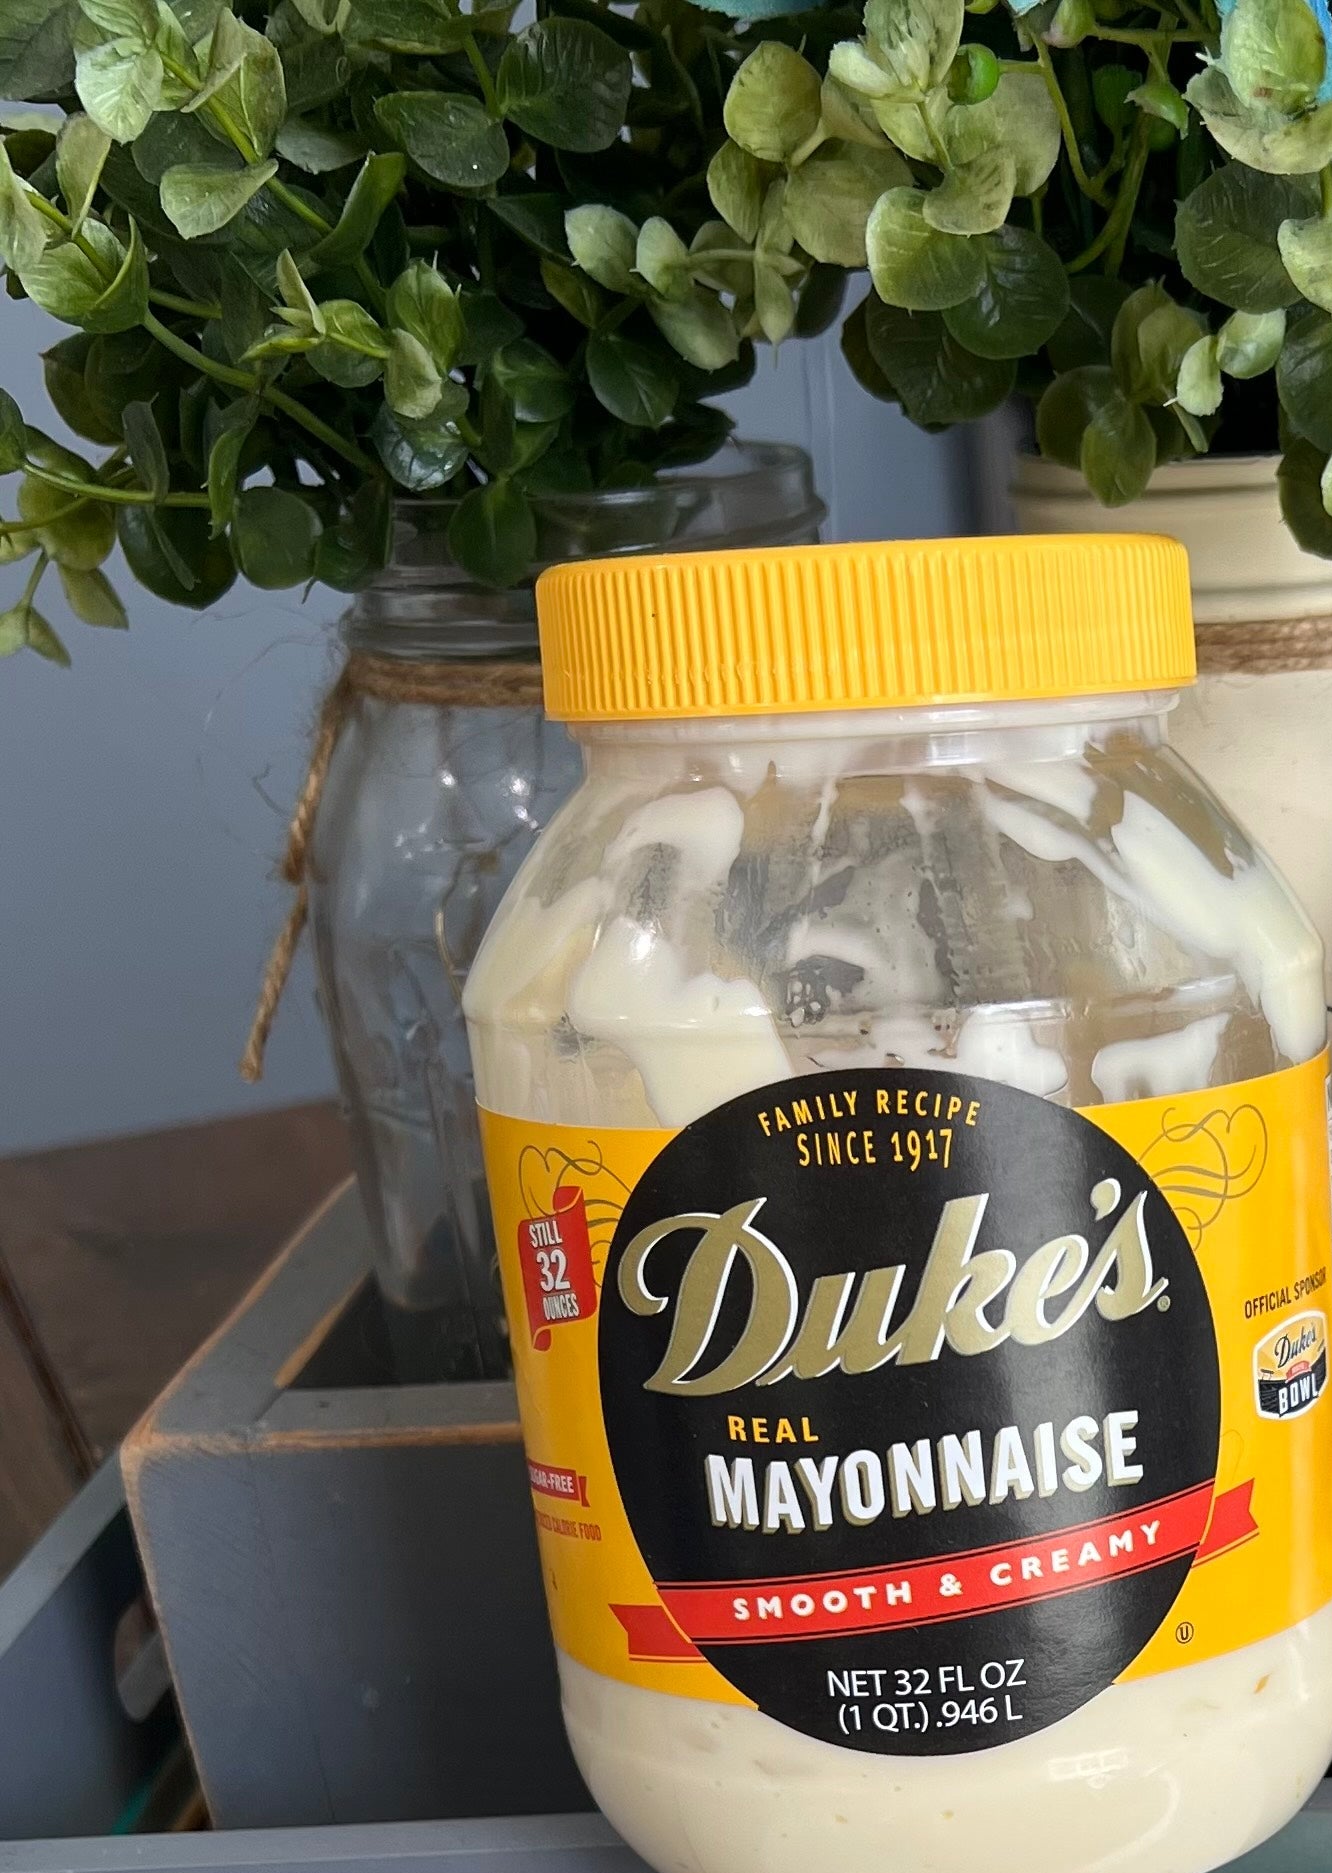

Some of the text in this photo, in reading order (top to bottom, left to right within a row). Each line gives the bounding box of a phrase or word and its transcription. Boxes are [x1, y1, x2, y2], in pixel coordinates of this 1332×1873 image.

[758, 1089, 981, 1137] FAMILY RECIPE
[797, 1128, 953, 1172] SINCE 1917
[528, 1220, 563, 1249] STILL
[535, 1249, 571, 1293] 32
[618, 1177, 1169, 1397] Duke's
[1244, 1266, 1327, 1319] OFFICIAL SPONSOR
[543, 1293, 580, 1321] OUNCES
[1278, 1373, 1319, 1415] BOWL
[727, 1414, 819, 1444] REAL
[704, 1409, 1144, 1535] MAYONNAISE
[578, 1522, 602, 1541] FOOD
[733, 1520, 1161, 1622] SMOOTH & CREAMY
[826, 1658, 1027, 1697] NET 32 FL OZ
[838, 1694, 1024, 1735] (1 QT.) .946 L
